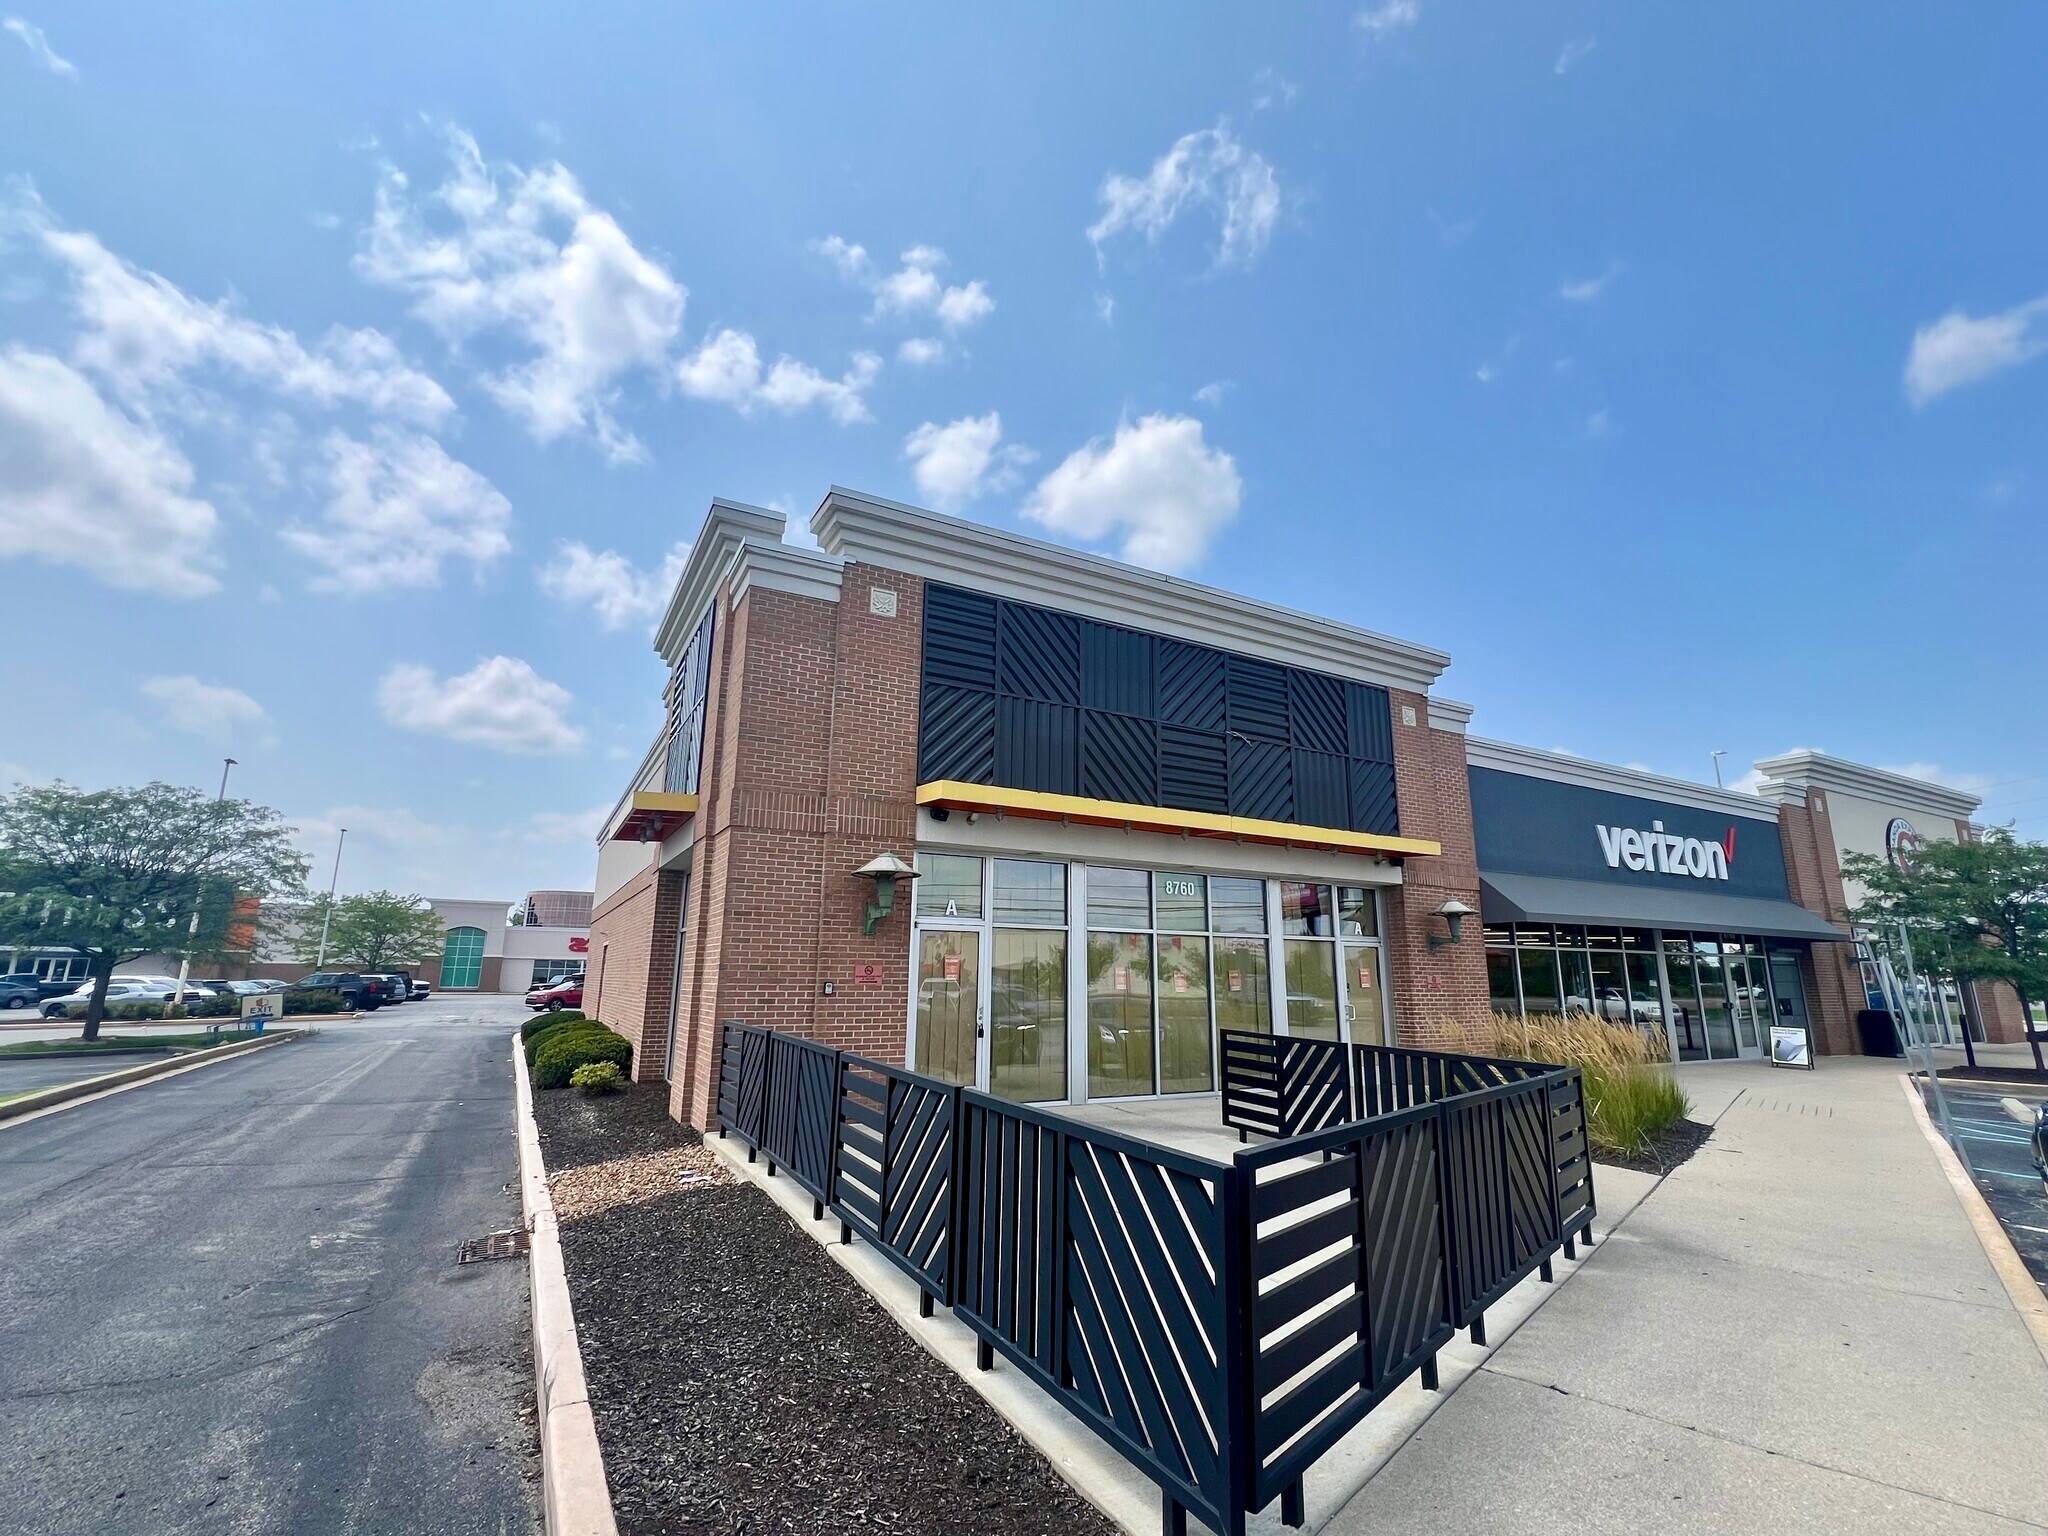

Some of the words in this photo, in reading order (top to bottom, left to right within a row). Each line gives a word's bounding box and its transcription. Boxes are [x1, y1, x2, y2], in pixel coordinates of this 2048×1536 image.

[1595, 820, 1729, 880] verizon
[1165, 881, 1195, 896] 8760
[945, 899, 958, 916] A
[1354, 921, 1363, 935] A
[249, 1005, 273, 1014] EXIT
